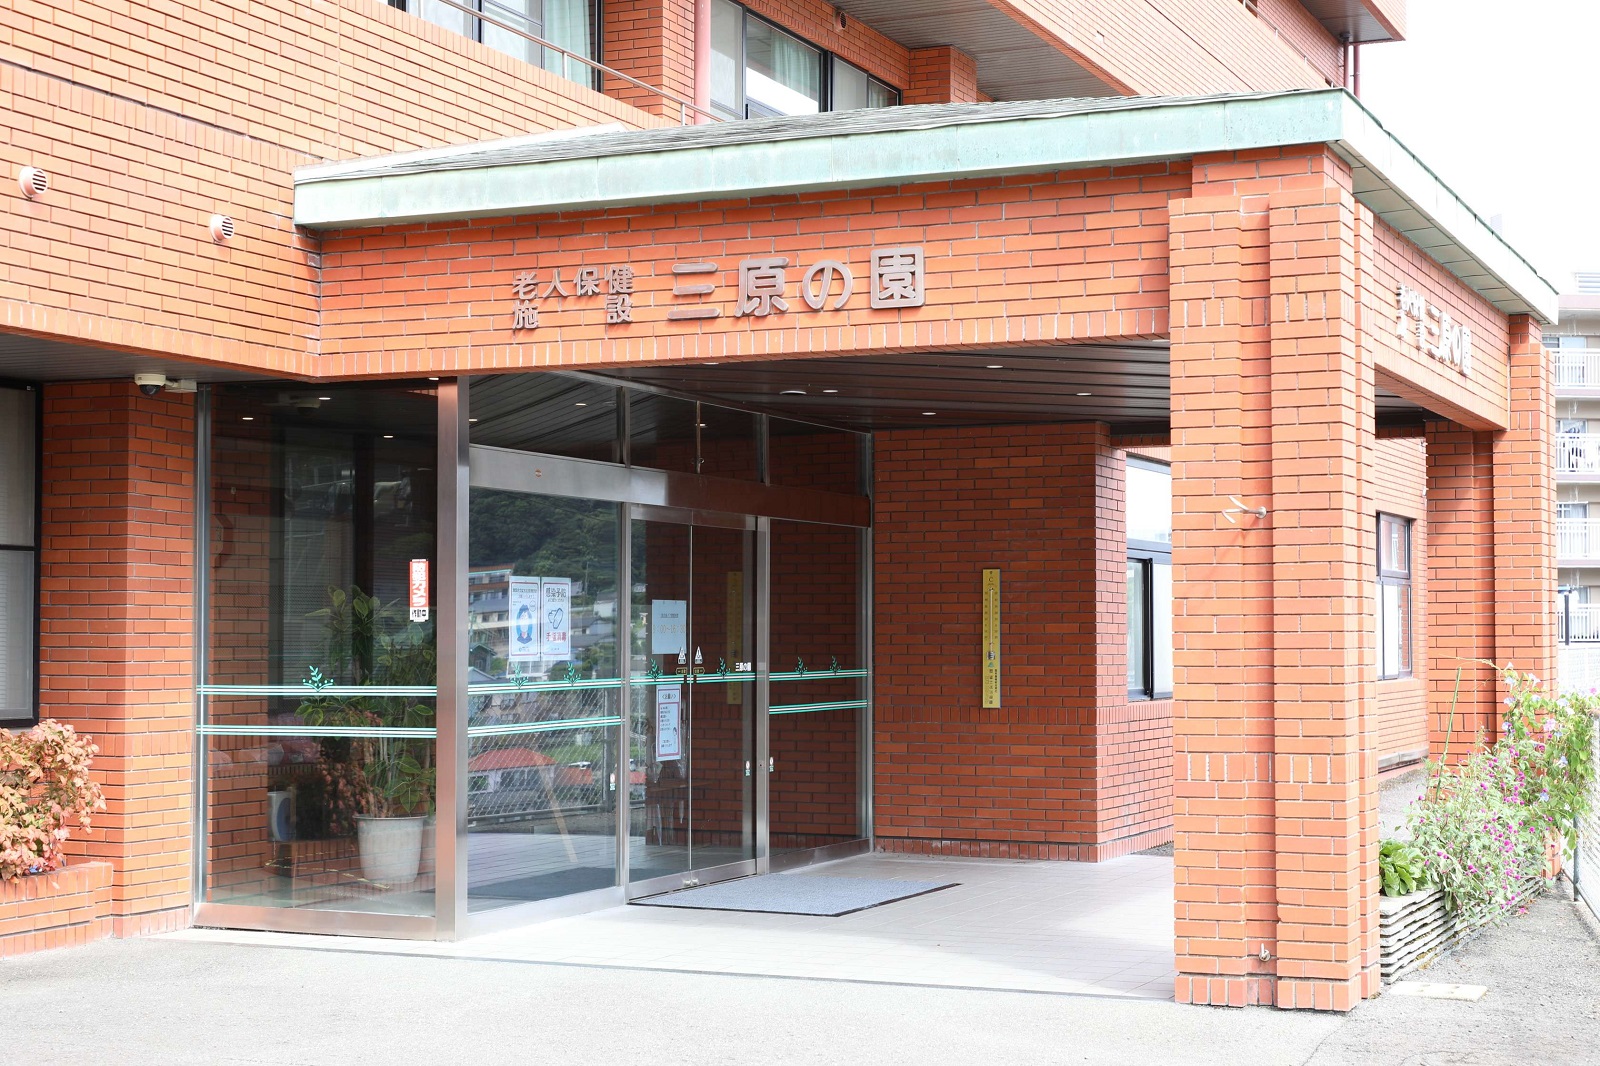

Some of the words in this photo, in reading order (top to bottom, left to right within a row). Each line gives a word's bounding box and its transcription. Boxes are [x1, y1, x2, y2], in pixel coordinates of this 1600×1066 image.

[512, 264, 635, 300] 老人保健
[667, 246, 926, 320] 三原の園
[512, 294, 634, 331] 施設
